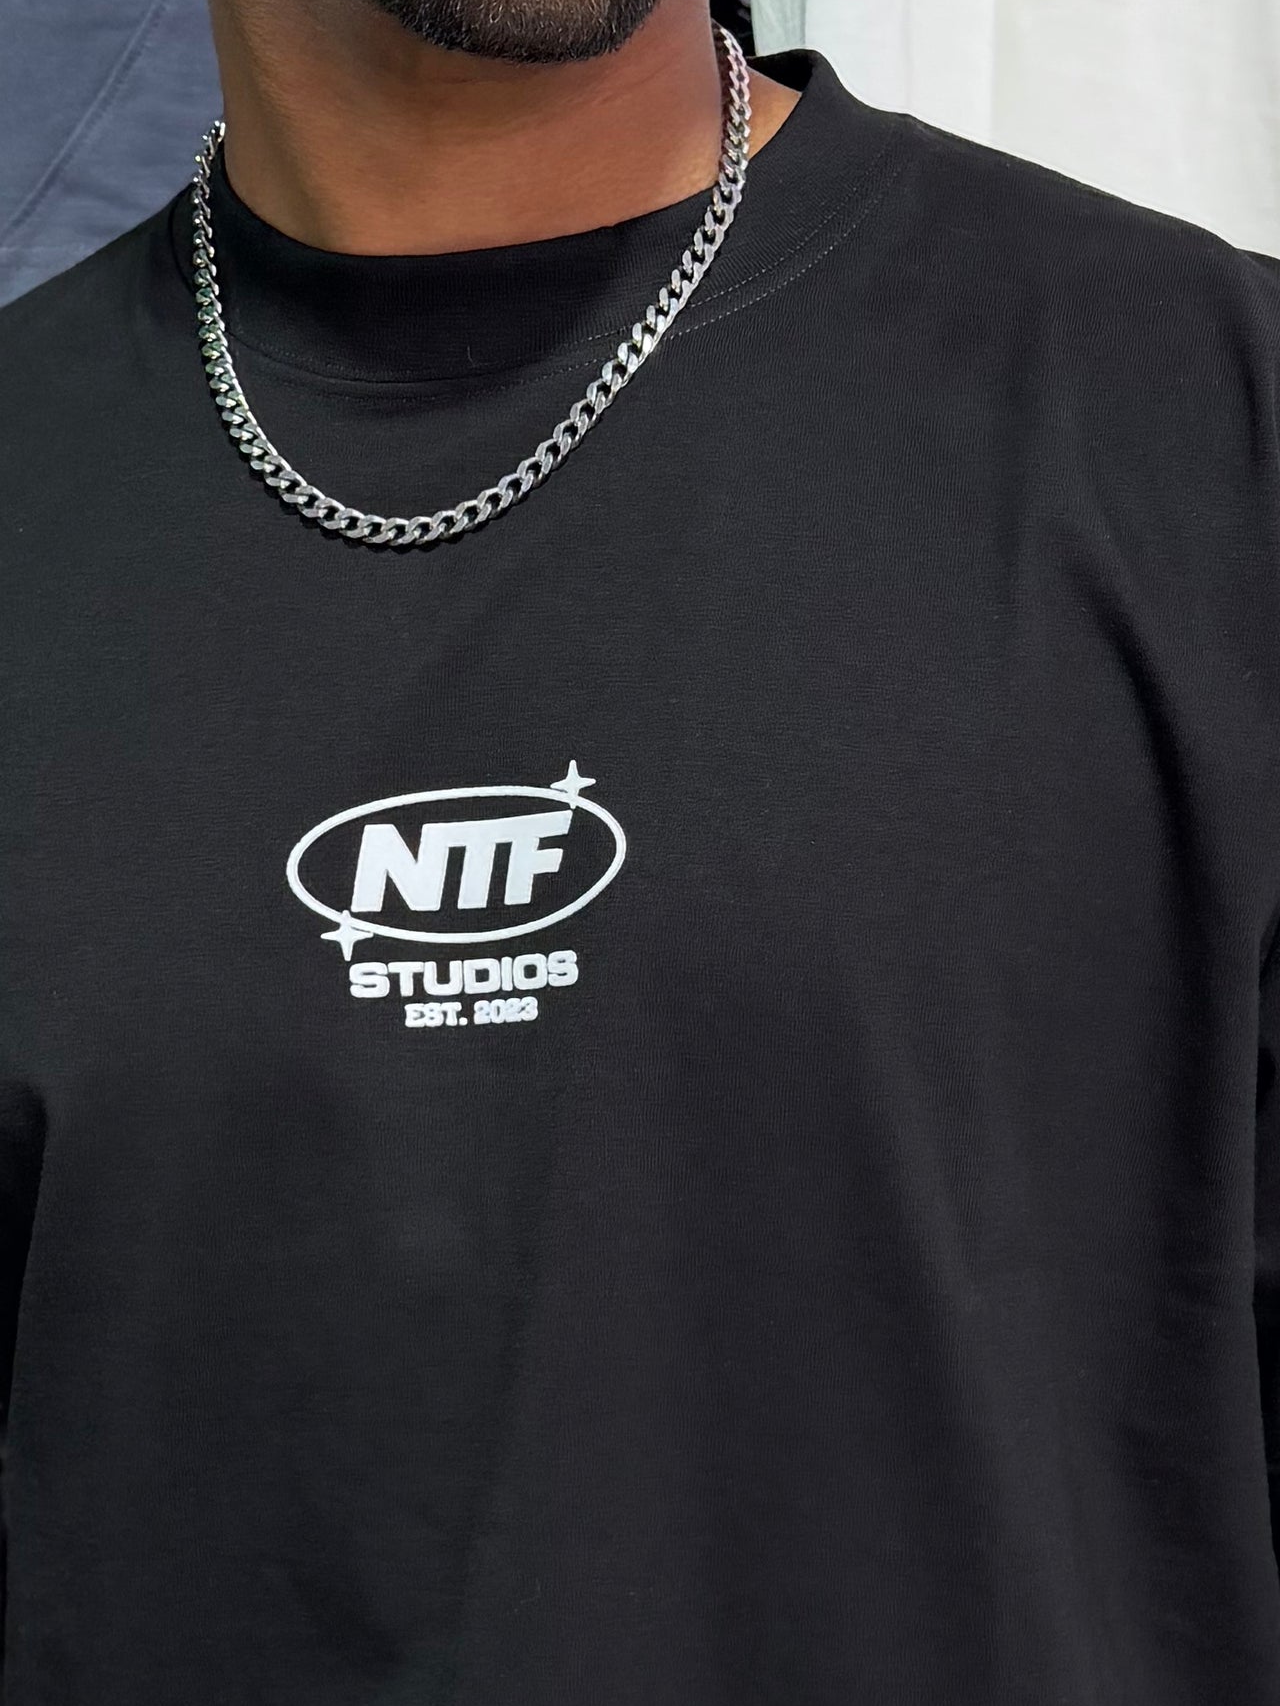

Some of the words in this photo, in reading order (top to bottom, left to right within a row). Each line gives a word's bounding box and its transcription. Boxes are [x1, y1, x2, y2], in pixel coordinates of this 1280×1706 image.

[350, 810, 573, 913] NTF
[348, 949, 580, 999] STUDIOS
[404, 1002, 468, 1028] EST.
[474, 996, 538, 1025] 2023
